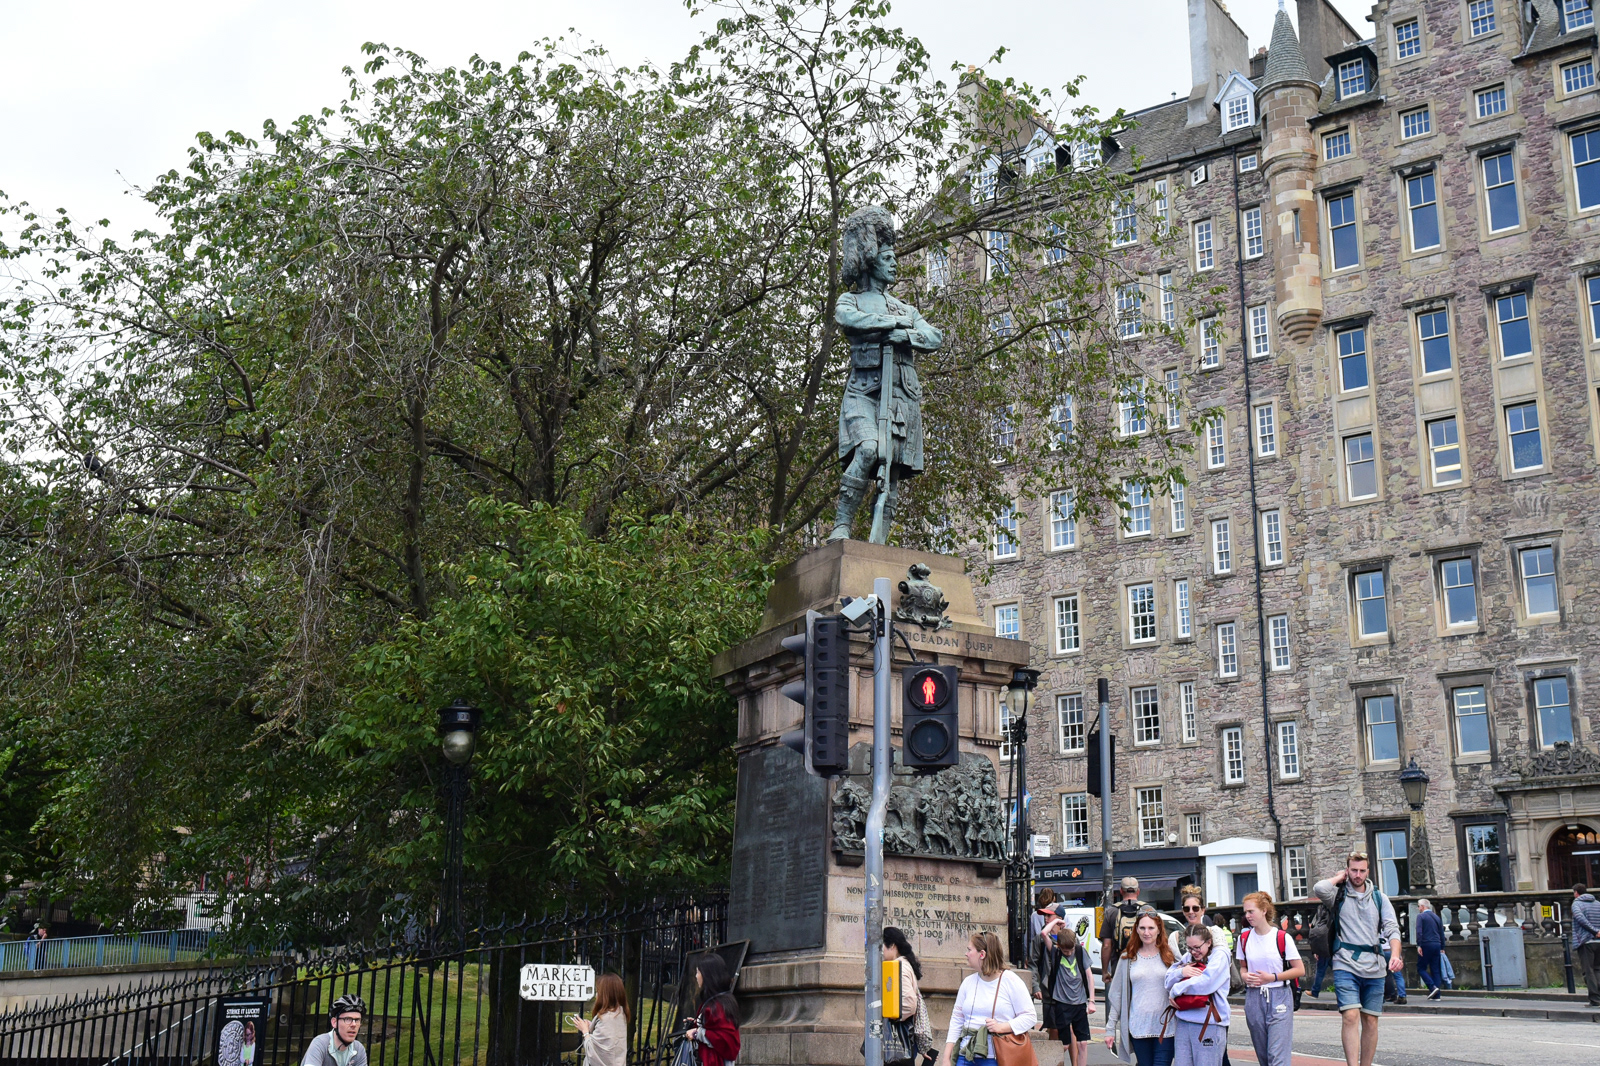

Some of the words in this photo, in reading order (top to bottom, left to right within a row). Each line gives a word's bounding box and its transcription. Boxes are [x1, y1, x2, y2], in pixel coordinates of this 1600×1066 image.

[894, 872, 908, 880] THE
[914, 874, 944, 883] MEMORY
[1044, 869, 1069, 878] BAR
[902, 882, 936, 891] OFFICERS
[928, 893, 961, 902] OFFICERS
[974, 896, 990, 904] MEN
[893, 907, 930, 919] BLACK
[934, 910, 971, 921] WATCH
[1543, 907, 1549, 916] H
[839, 915, 859, 923] WHO
[885, 918, 893, 926] IN
[898, 919, 911, 927] THE
[916, 920, 941, 928] SOUTH
[945, 923, 977, 931] AFRICAN
[924, 930, 942, 938] 1902
[527, 967, 591, 982] MARKET
[530, 983, 585, 998] STREET
